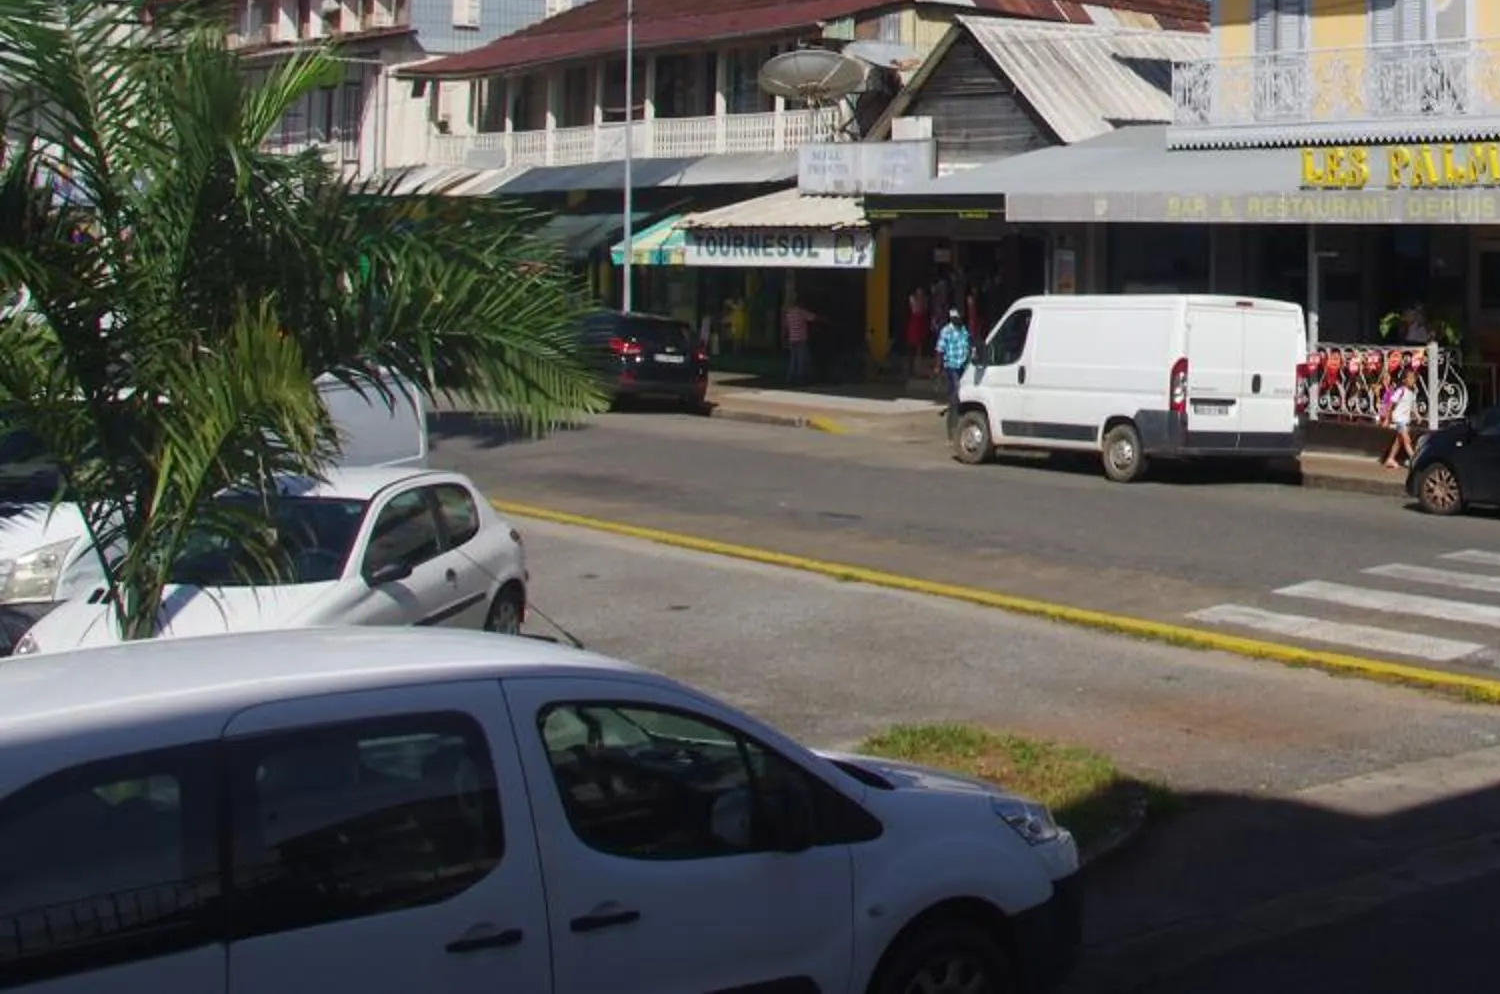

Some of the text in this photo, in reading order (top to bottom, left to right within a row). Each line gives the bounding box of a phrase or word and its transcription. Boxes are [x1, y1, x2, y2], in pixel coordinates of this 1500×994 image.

[1301, 146, 1369, 187] LES
[1166, 195, 1207, 217] BAR
[1220, 195, 1234, 217] &
[1247, 195, 1392, 217] RESTAURANT
[1407, 195, 1497, 218] DEPUIS
[694, 231, 819, 258] TOURNESOL
